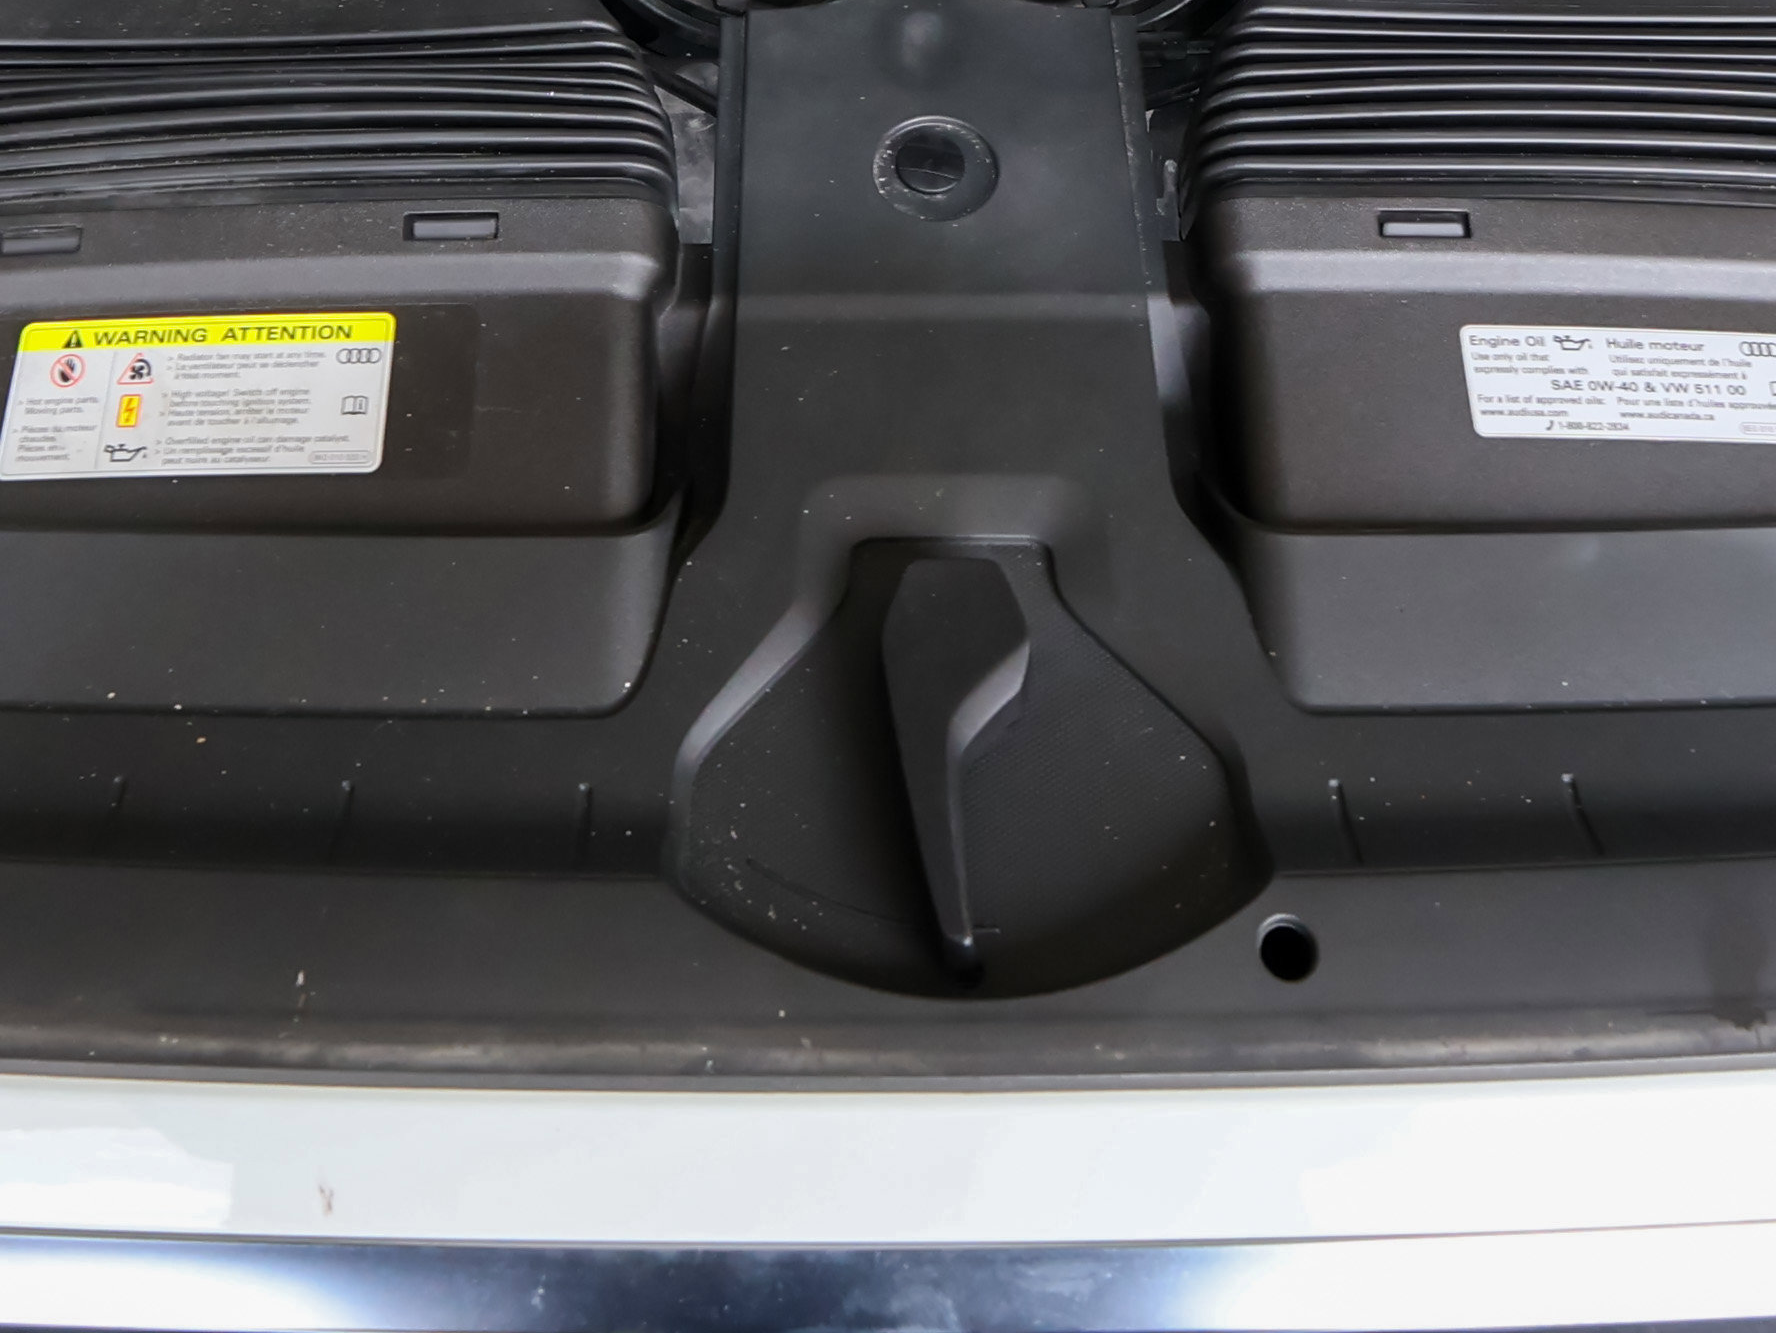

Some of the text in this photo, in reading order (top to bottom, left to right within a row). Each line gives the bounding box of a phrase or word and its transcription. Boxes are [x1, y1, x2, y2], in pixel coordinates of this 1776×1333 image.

[94, 323, 353, 346] WARNING ATTENTION
[1469, 335, 1546, 348] Engine Oil
[1605, 338, 1705, 351] Huile moteur
[1471, 352, 1490, 360] Use
[1492, 353, 1512, 362] only
[1530, 353, 1549, 361] that
[1646, 357, 1706, 367] uniquement
[1707, 358, 1720, 366] de
[1473, 365, 1588, 375] expressly complies with
[1550, 379, 1747, 395] SAE 0W-40 & VW 511 00
[1477, 394, 1494, 402] For
[1506, 395, 1520, 403] list
[1522, 395, 1533, 403] of
[1536, 396, 1582, 405] approved
[1615, 396, 1640, 405] Pour
